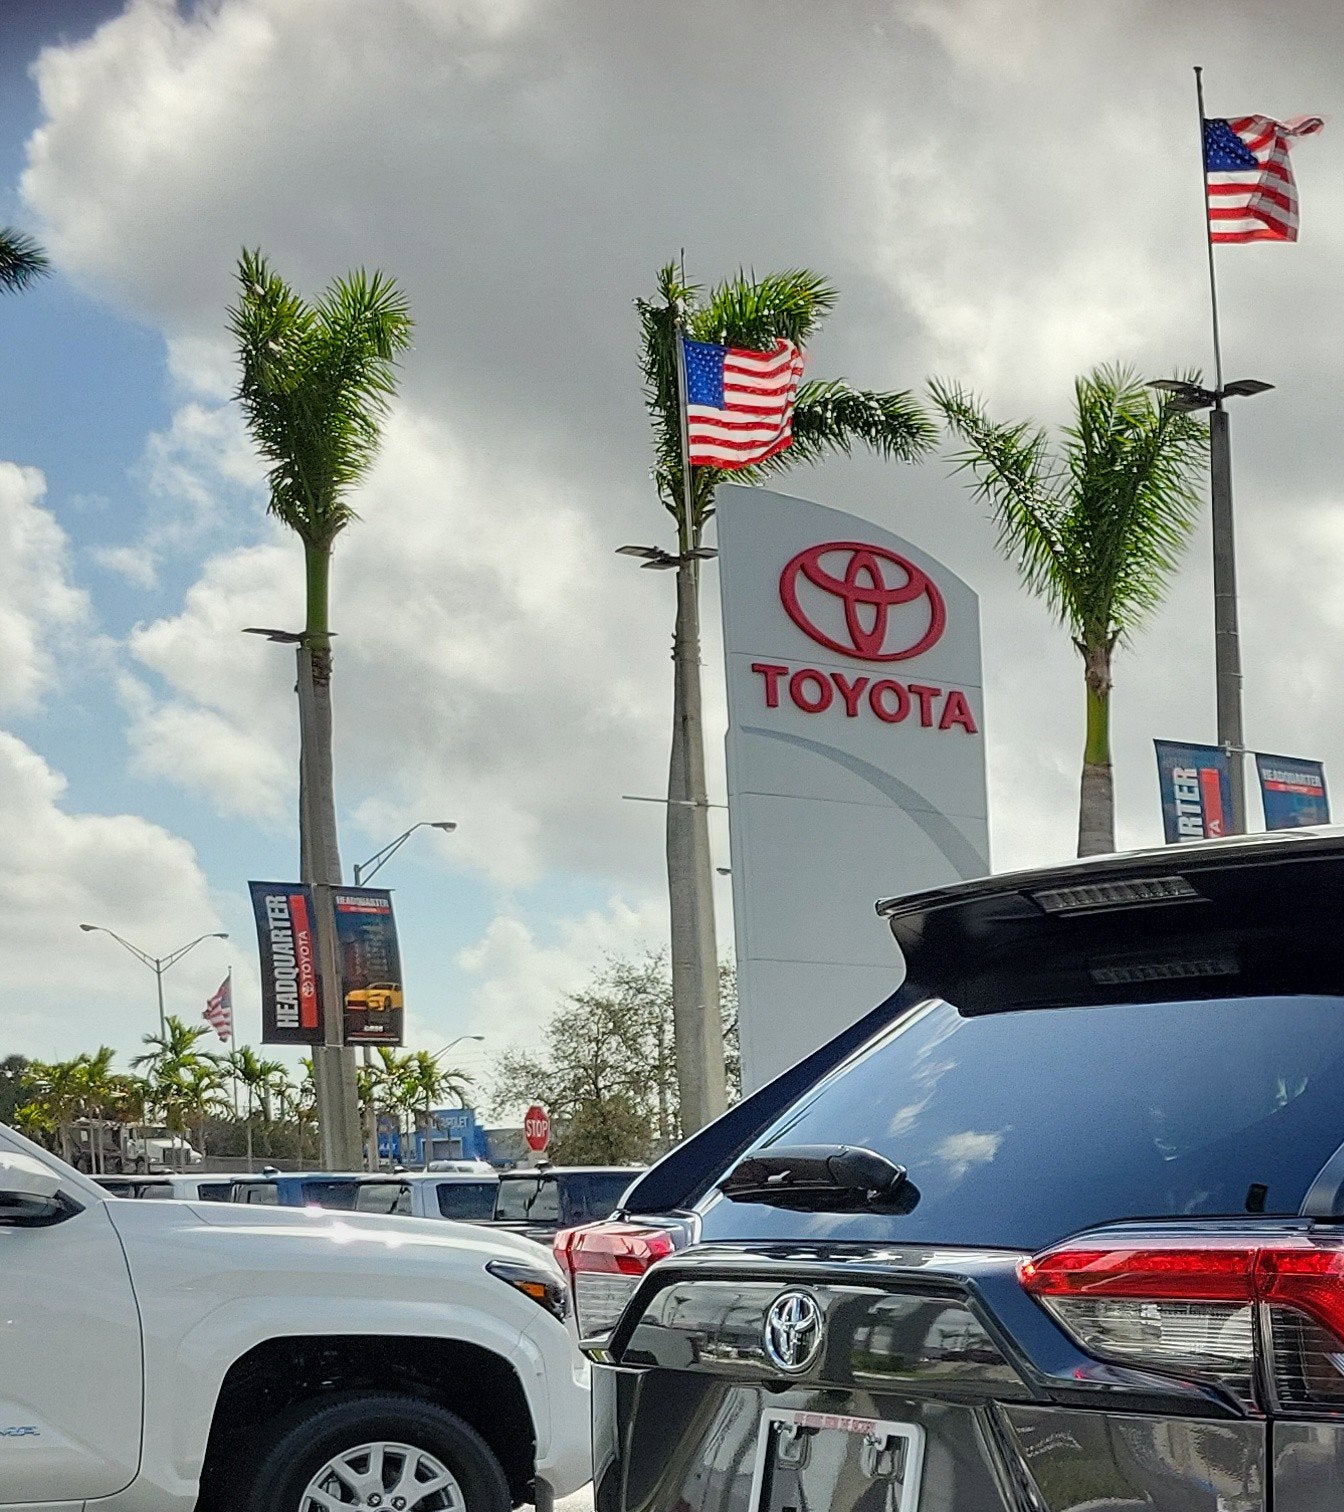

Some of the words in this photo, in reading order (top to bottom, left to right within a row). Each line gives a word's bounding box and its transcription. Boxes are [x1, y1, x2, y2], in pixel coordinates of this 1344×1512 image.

[751, 662, 979, 734] TOYOTA
[266, 895, 299, 1028] HEADQUARTER
[299, 930, 312, 980] TOYOTA
[526, 1119, 548, 1138] STOP
